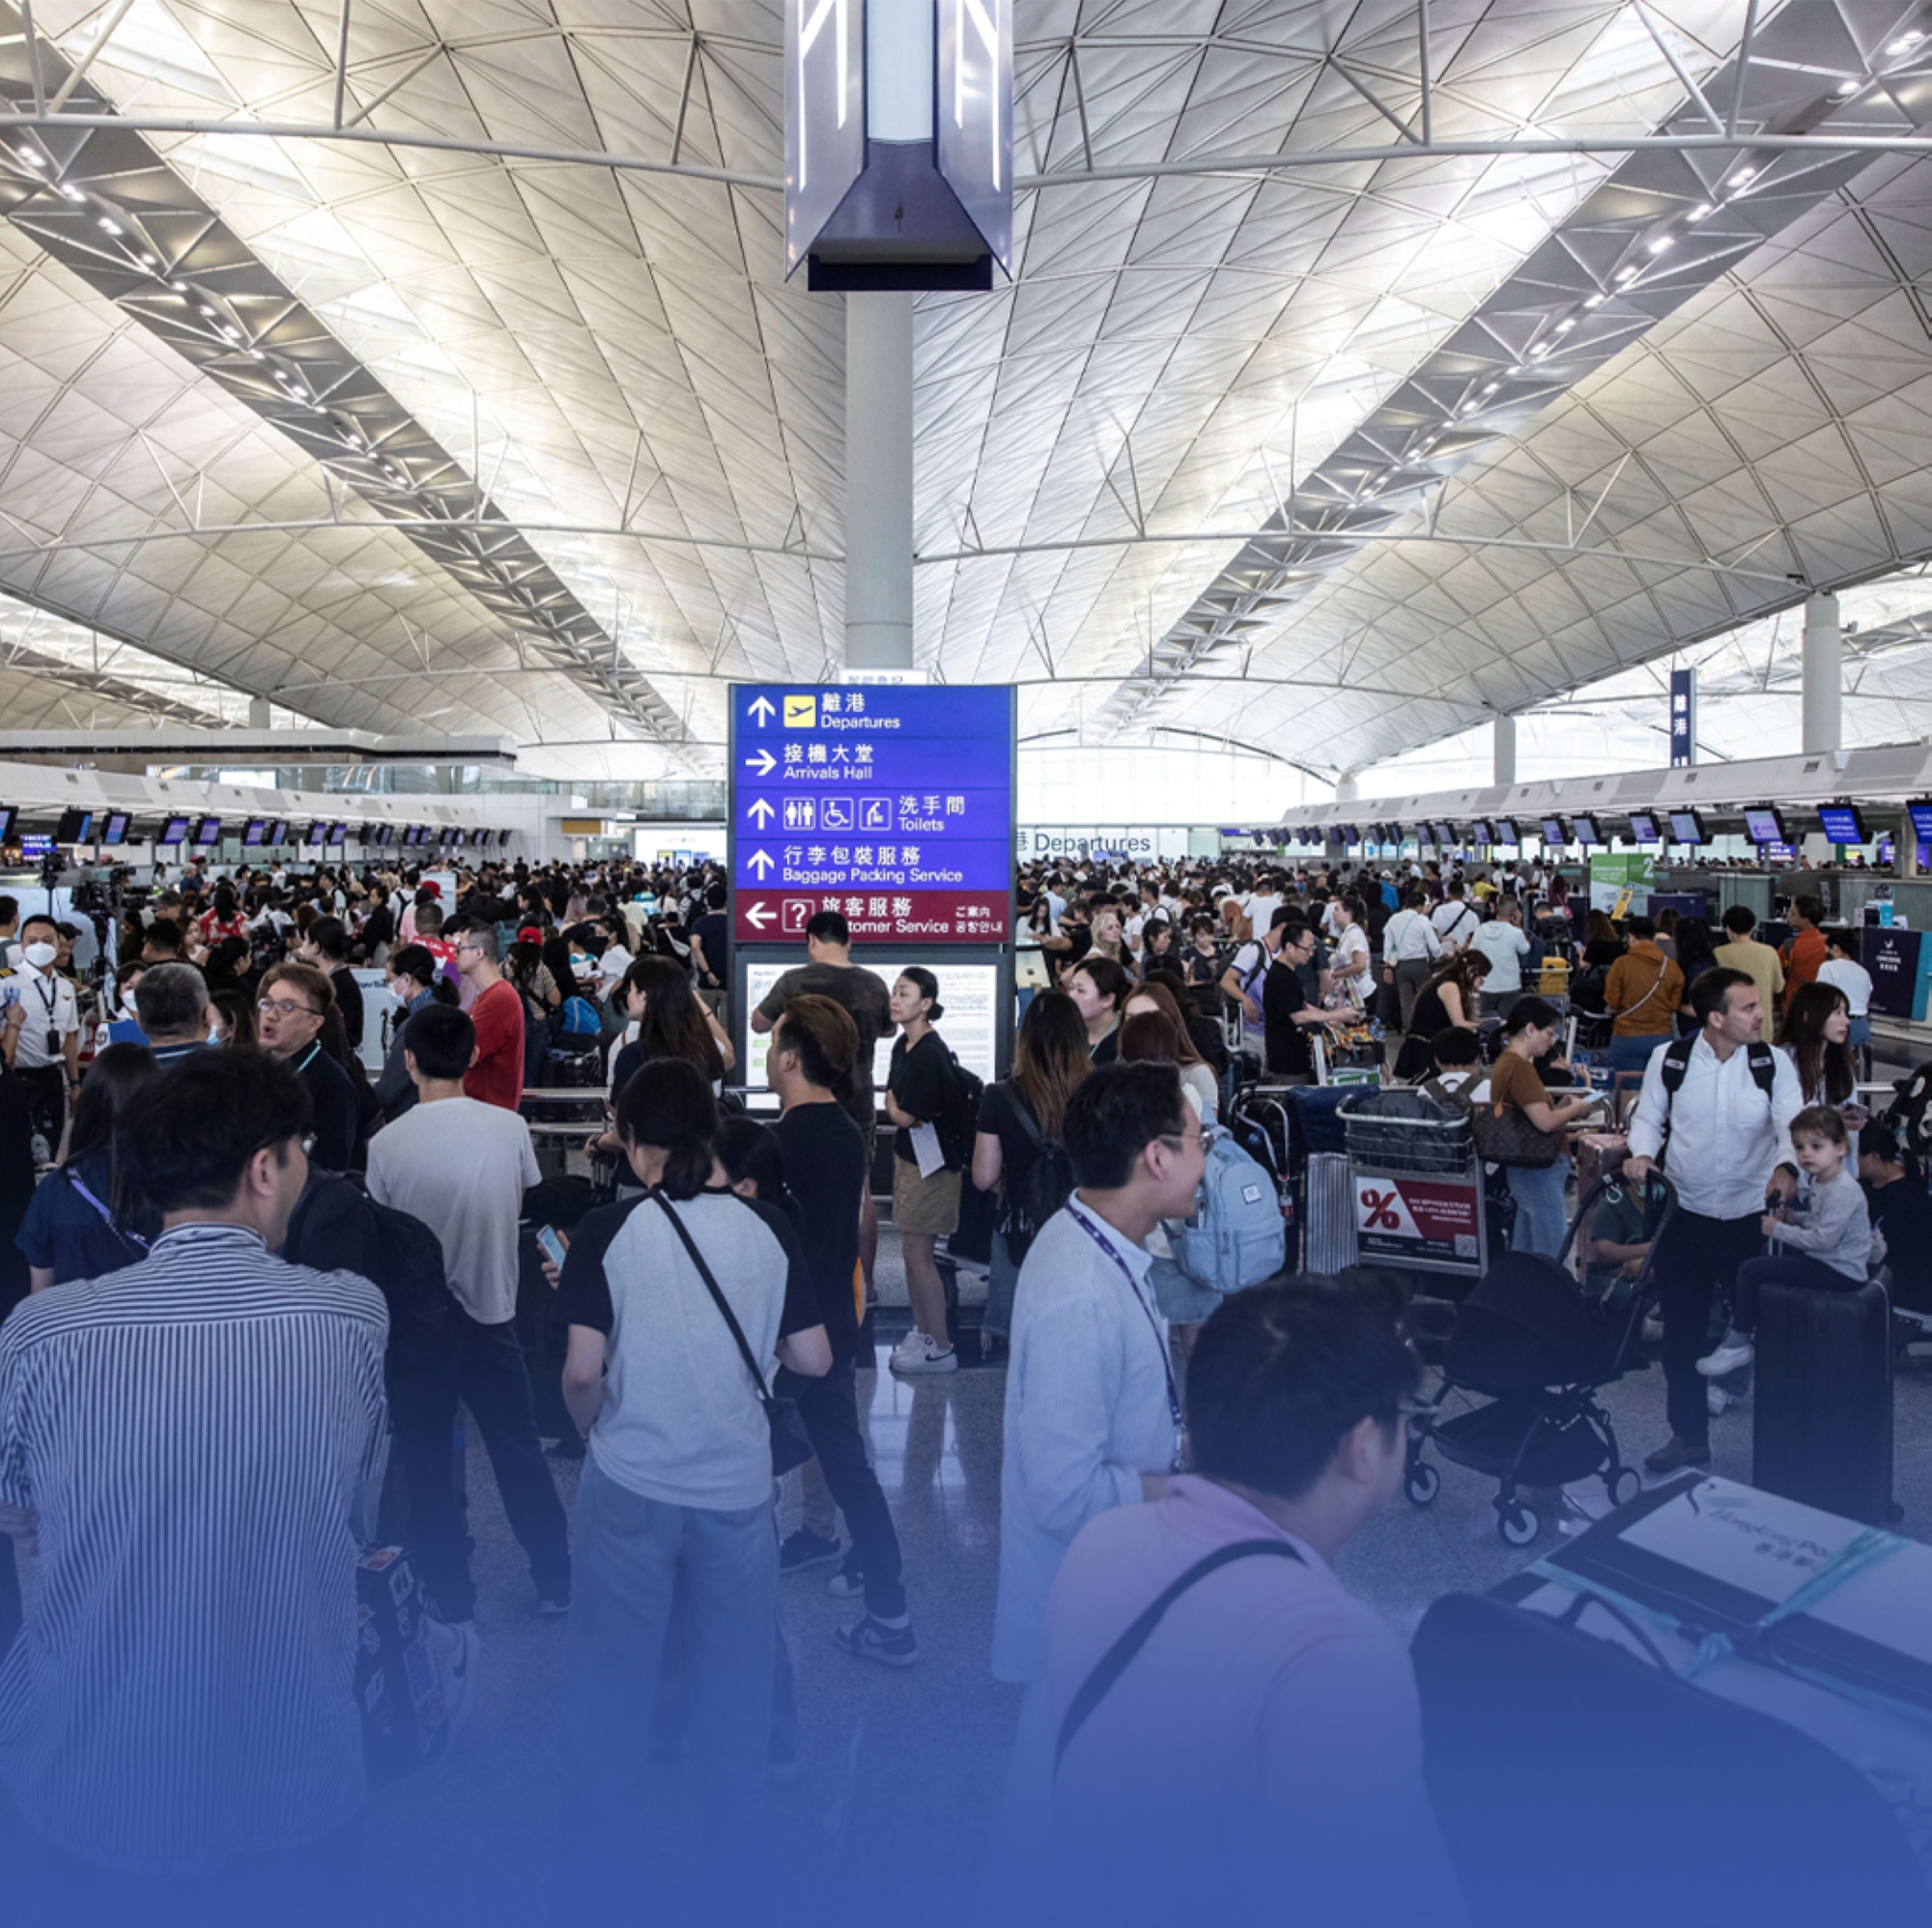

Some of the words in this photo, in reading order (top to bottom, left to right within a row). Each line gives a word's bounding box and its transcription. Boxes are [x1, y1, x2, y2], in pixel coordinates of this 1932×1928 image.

[821, 692, 866, 713] 離港
[821, 715, 900, 731] Departures
[783, 743, 873, 764] 接機大堂
[783, 765, 839, 780] Arrivals
[844, 765, 872, 780] Hall
[898, 794, 966, 816] 洗手間
[898, 816, 945, 832] Toilets
[783, 845, 921, 866] 行李包裝服務
[1035, 834, 1151, 857] Departures
[783, 867, 846, 885] Baggage
[851, 867, 905, 885] Packing
[909, 867, 964, 883] Service
[1643, 857, 1654, 878] 2
[821, 895, 913, 918] 旅客服務
[846, 920, 893, 933] tomer
[895, 919, 950, 933] Service
